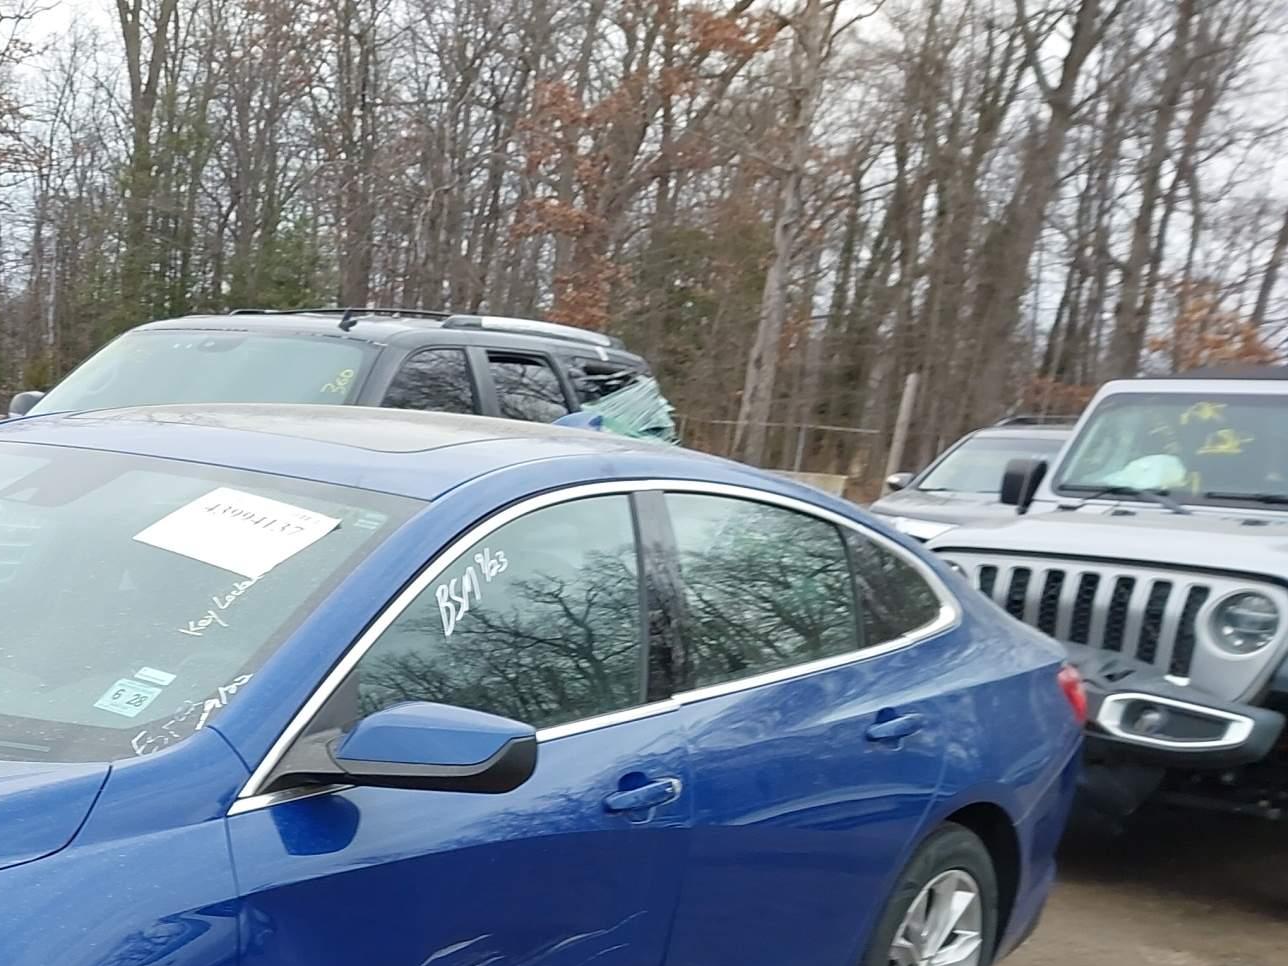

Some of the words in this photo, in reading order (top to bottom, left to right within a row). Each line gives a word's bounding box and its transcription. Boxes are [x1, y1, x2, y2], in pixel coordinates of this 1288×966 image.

[204, 503, 305, 536] 43994137
[177, 610, 229, 636] Key
[112, 688, 126, 700] 6
[126, 693, 148, 707] 28
